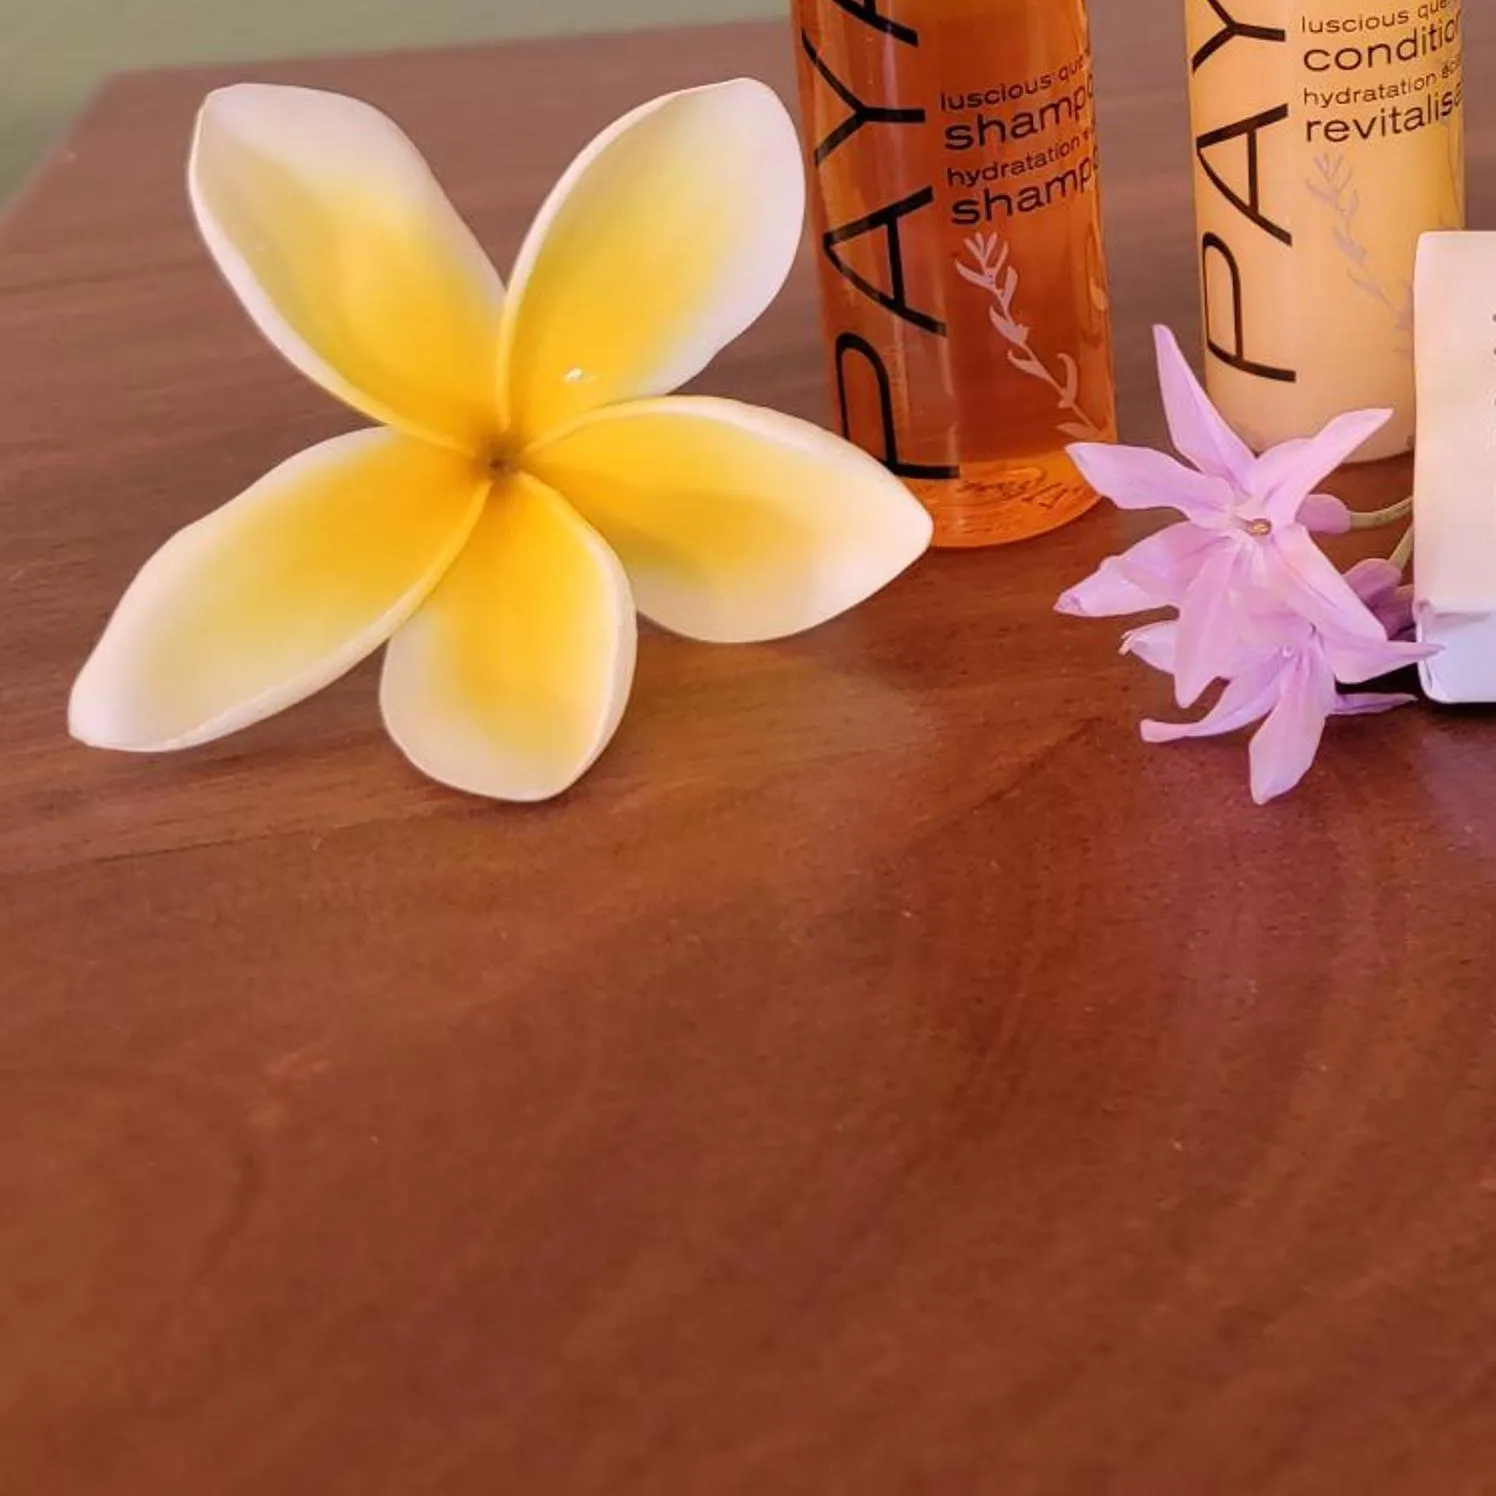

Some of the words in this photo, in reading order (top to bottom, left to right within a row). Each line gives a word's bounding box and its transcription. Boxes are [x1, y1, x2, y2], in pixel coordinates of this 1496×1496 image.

[1302, 10, 1409, 34] luscious
[939, 72, 1053, 112] luscious
[1303, 73, 1436, 108] hydratation
[946, 133, 1081, 188] hydratation
